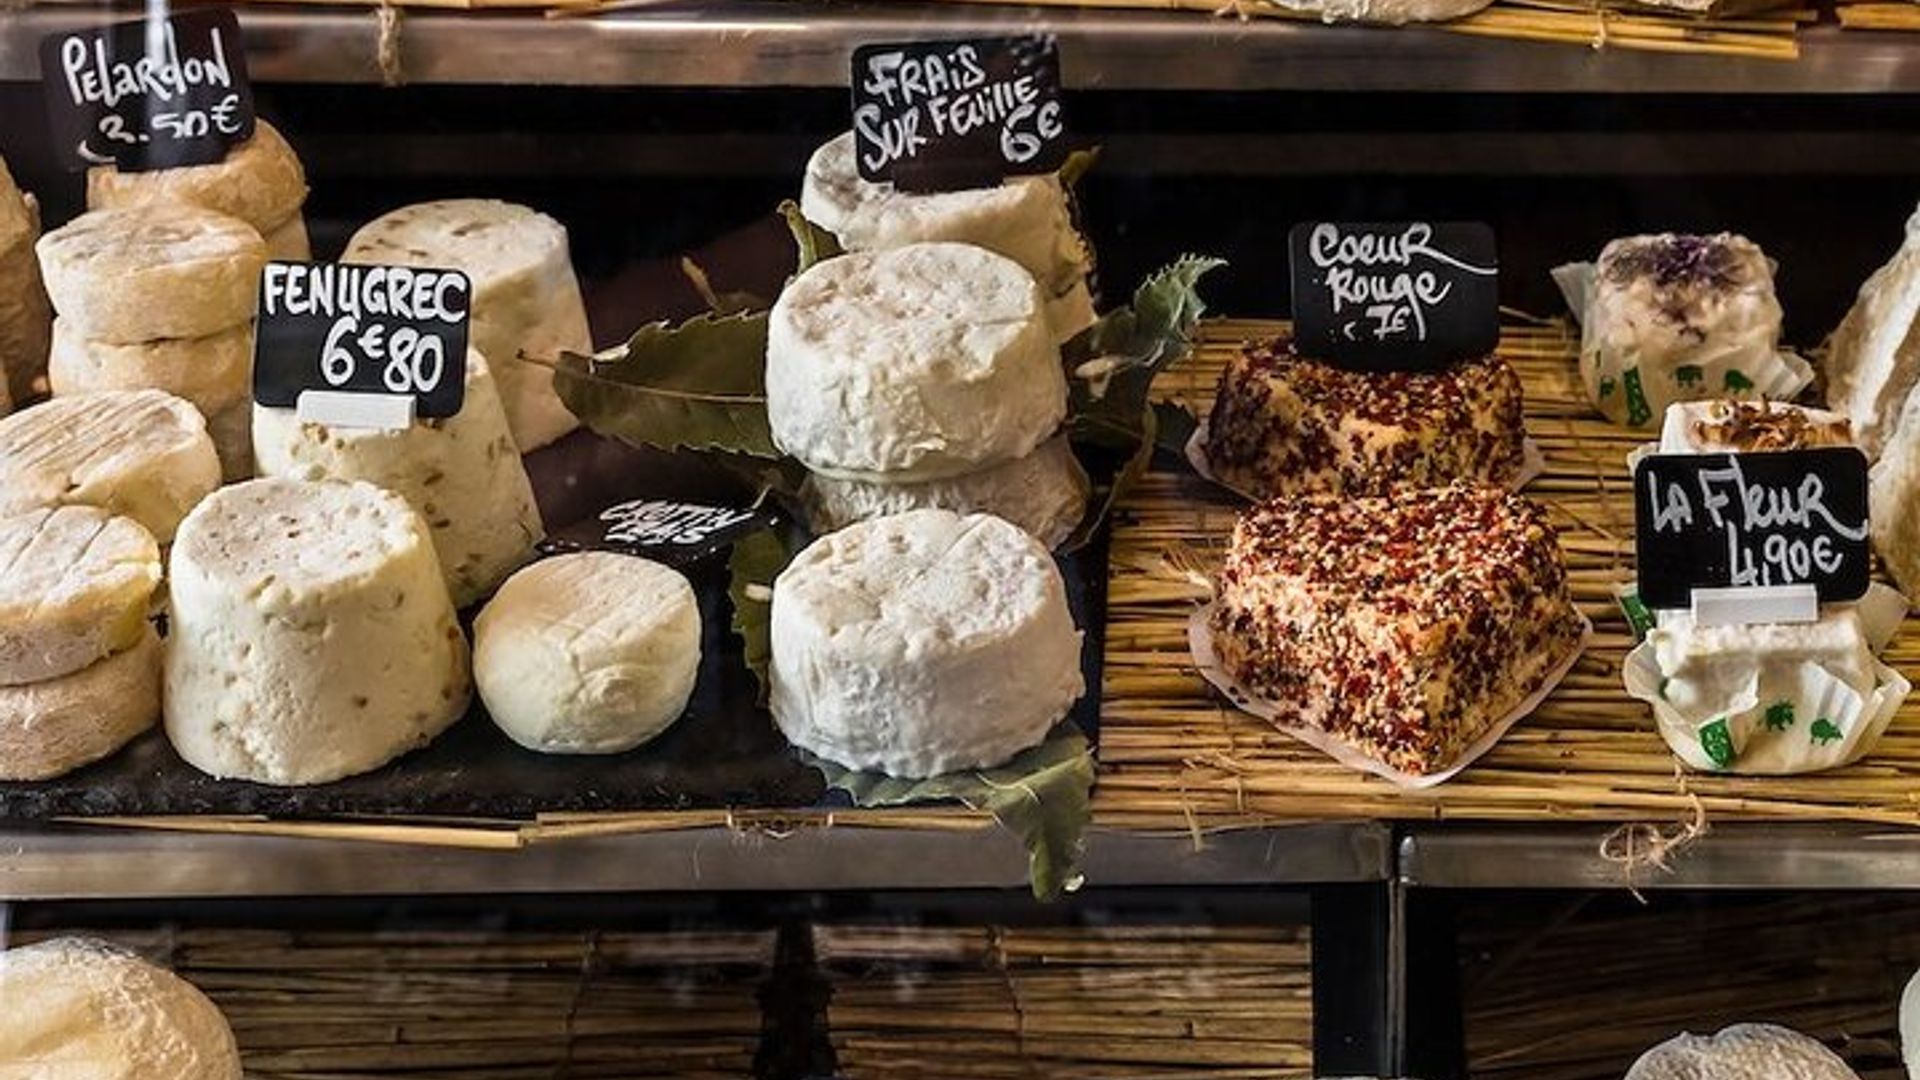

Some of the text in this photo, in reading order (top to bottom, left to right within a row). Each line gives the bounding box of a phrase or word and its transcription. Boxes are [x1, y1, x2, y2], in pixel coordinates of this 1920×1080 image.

[854, 103, 927, 172] SUR
[1000, 101, 1063, 163] 6€
[264, 263, 467, 322] FENUGREC
[321, 315, 444, 392] 6€80
